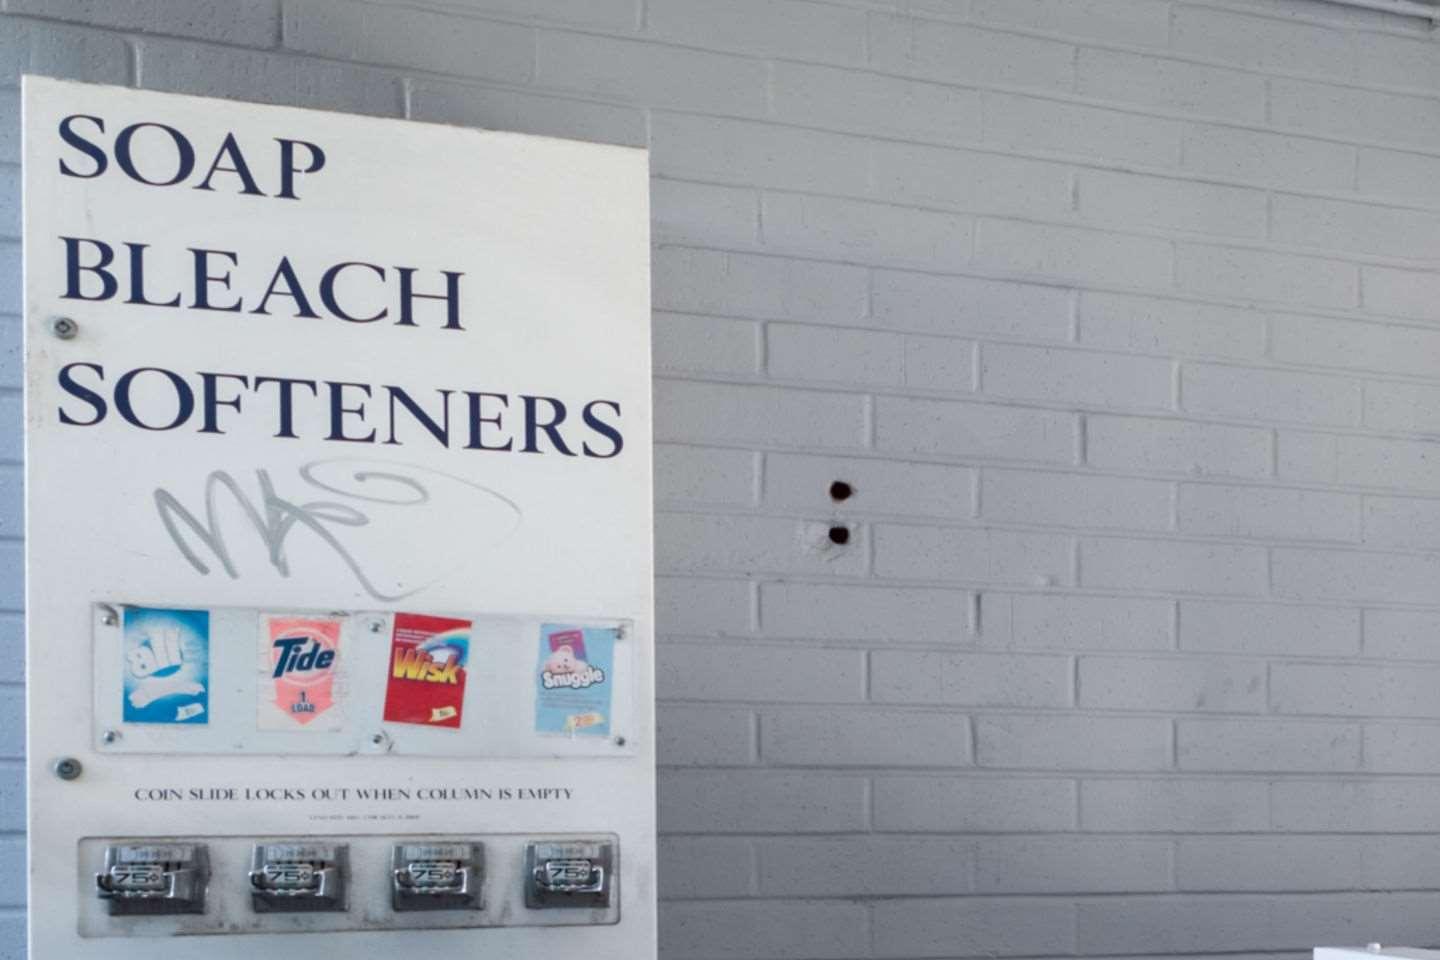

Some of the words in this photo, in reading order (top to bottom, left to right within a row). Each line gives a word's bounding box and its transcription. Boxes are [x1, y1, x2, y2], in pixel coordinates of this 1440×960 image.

[57, 114, 326, 200] SOAP
[58, 235, 466, 331] BLEACH
[57, 362, 624, 459] SOFTENERS
[272, 636, 336, 679] Tide
[392, 647, 458, 685] Wisk
[541, 665, 606, 690] Snuggle
[134, 787, 182, 801] COIN
[188, 787, 239, 801] SLIDE
[245, 787, 306, 801] LOCKS
[311, 787, 354, 801] OUT
[356, 787, 410, 801] WHEN
[416, 787, 493, 801] COLUMN
[498, 787, 512, 801] IS
[517, 787, 573, 801] EMPTY
